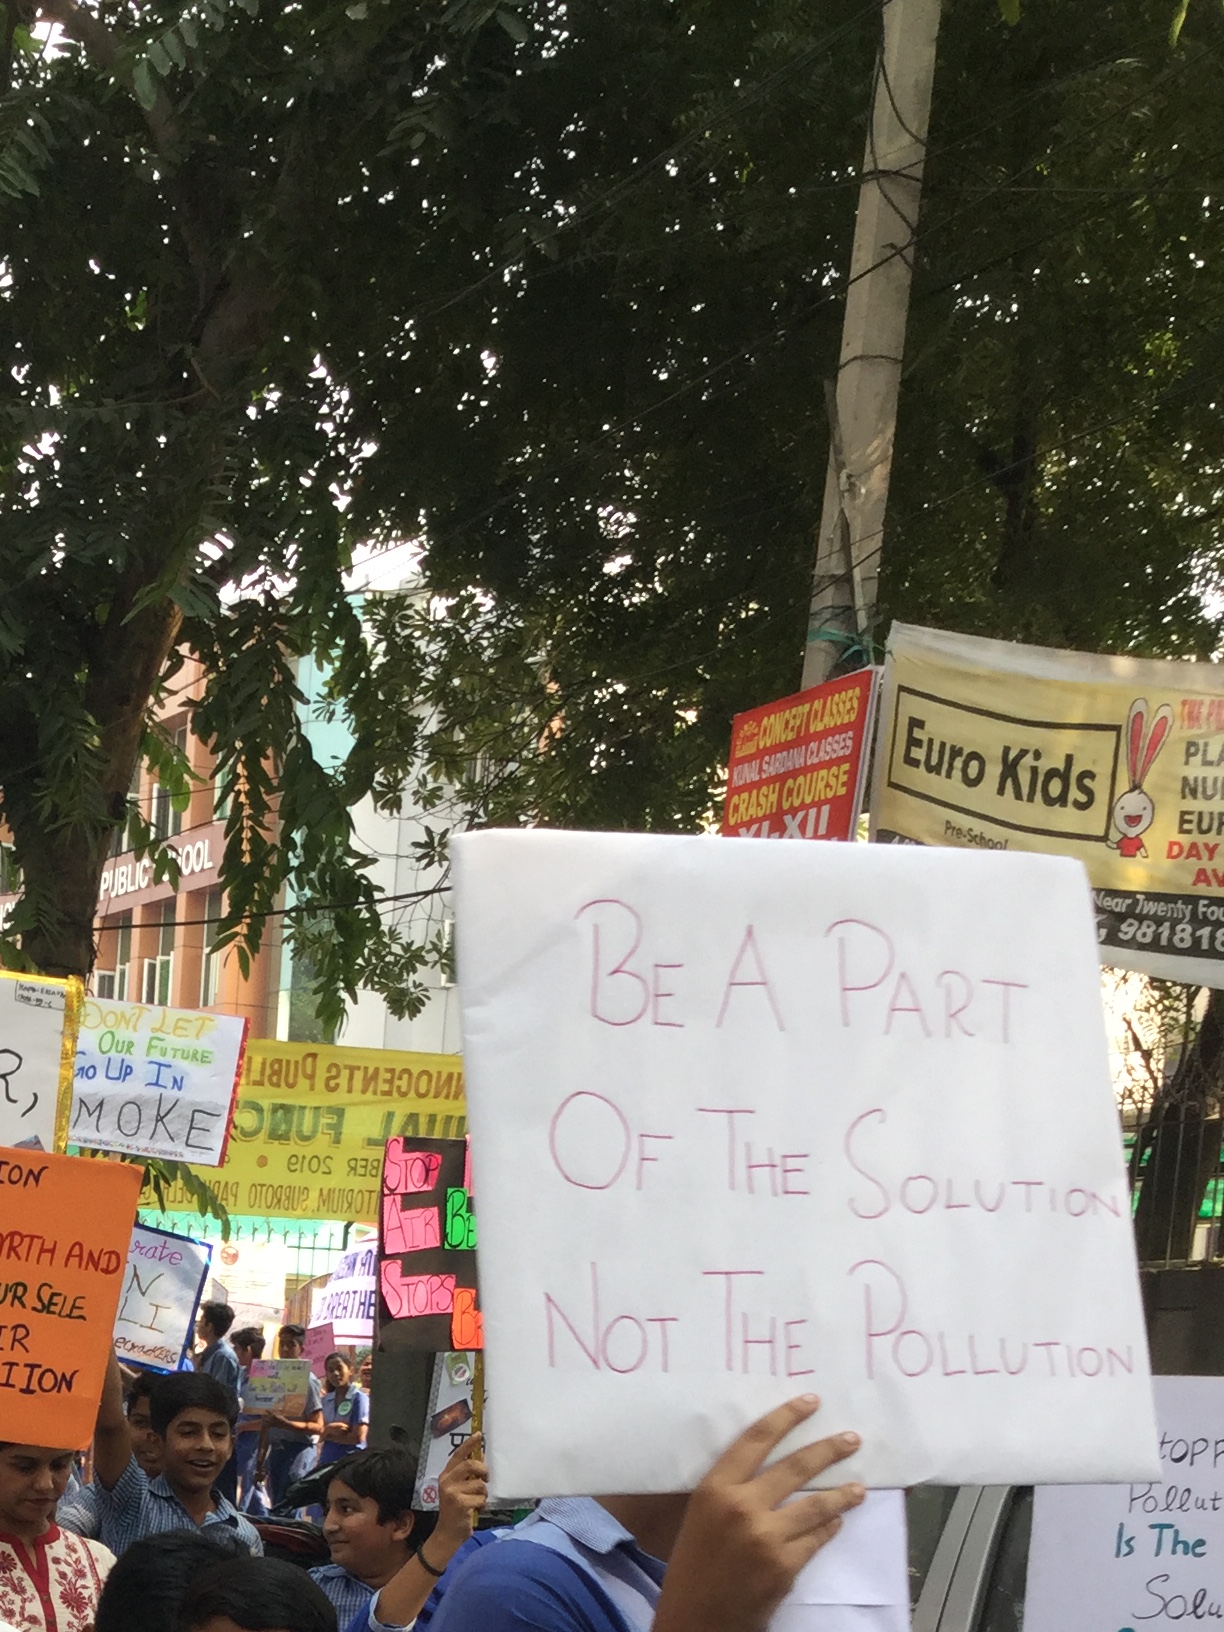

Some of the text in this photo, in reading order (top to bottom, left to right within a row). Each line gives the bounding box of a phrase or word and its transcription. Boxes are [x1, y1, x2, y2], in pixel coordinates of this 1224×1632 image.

[758, 702, 810, 749] CONCEPT
[809, 686, 861, 734] CLASSES
[732, 759, 760, 787] KUNAL
[806, 730, 854, 766] CLASSES
[903, 716, 1097, 811] Euro Kids
[728, 763, 851, 826] CRASH COURSE
[1166, 841, 1219, 862] DAY
[99, 858, 149, 901] PUBLIC
[1135, 894, 1193, 923] Twenty
[576, 899, 1030, 1044] BE A PART
[98, 1030, 213, 1064] OUR FUTURE
[150, 1008, 215, 1041] LET
[145, 1060, 185, 1092] IN
[384, 1138, 440, 1193] STOP
[548, 1091, 1123, 1220] OF THE SOLUTION
[385, 1196, 440, 1250] AIR
[64, 1241, 122, 1276] AND
[383, 1261, 455, 1318] STOPS
[544, 1259, 1135, 1380] NOT THE POLLUTION
[1115, 1522, 1207, 1559] Is The
